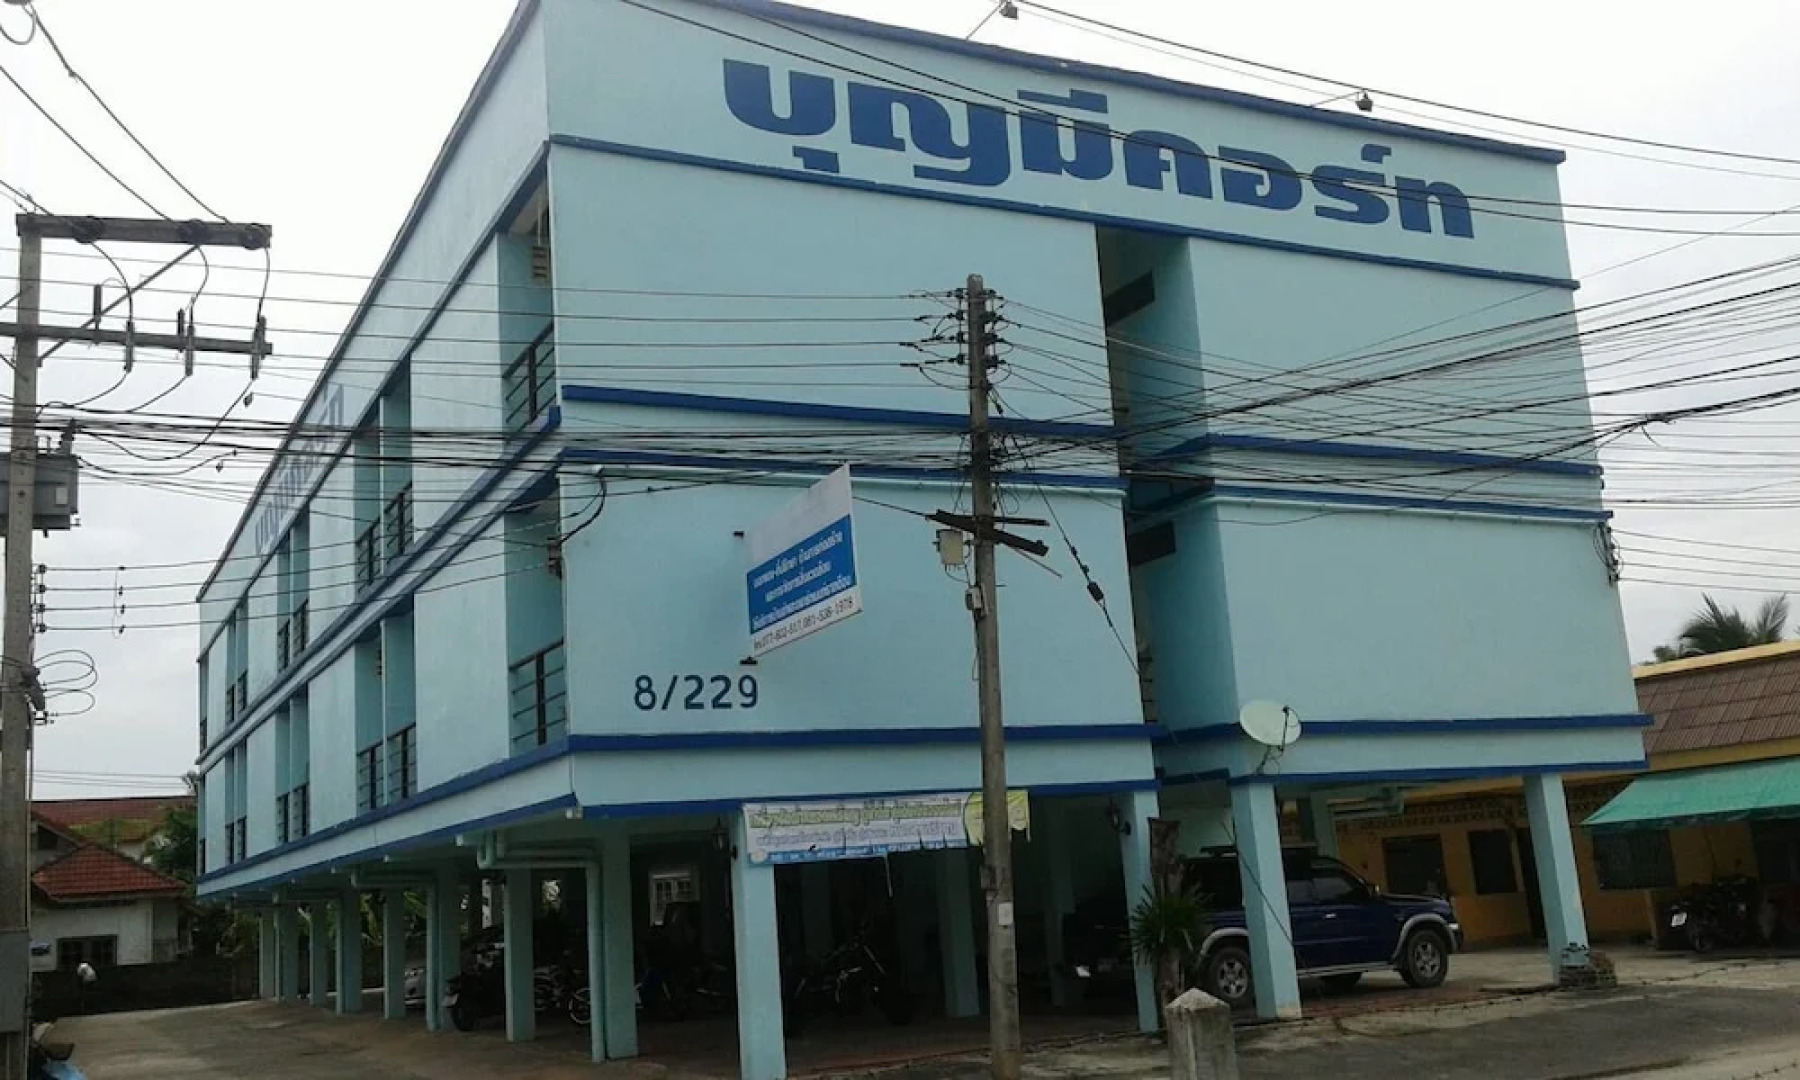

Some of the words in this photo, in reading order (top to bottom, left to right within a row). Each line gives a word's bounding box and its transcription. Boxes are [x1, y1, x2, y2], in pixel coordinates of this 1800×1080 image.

[723, 58, 1475, 239] บุญมีคอร์ท
[634, 674, 759, 711] 8/229
